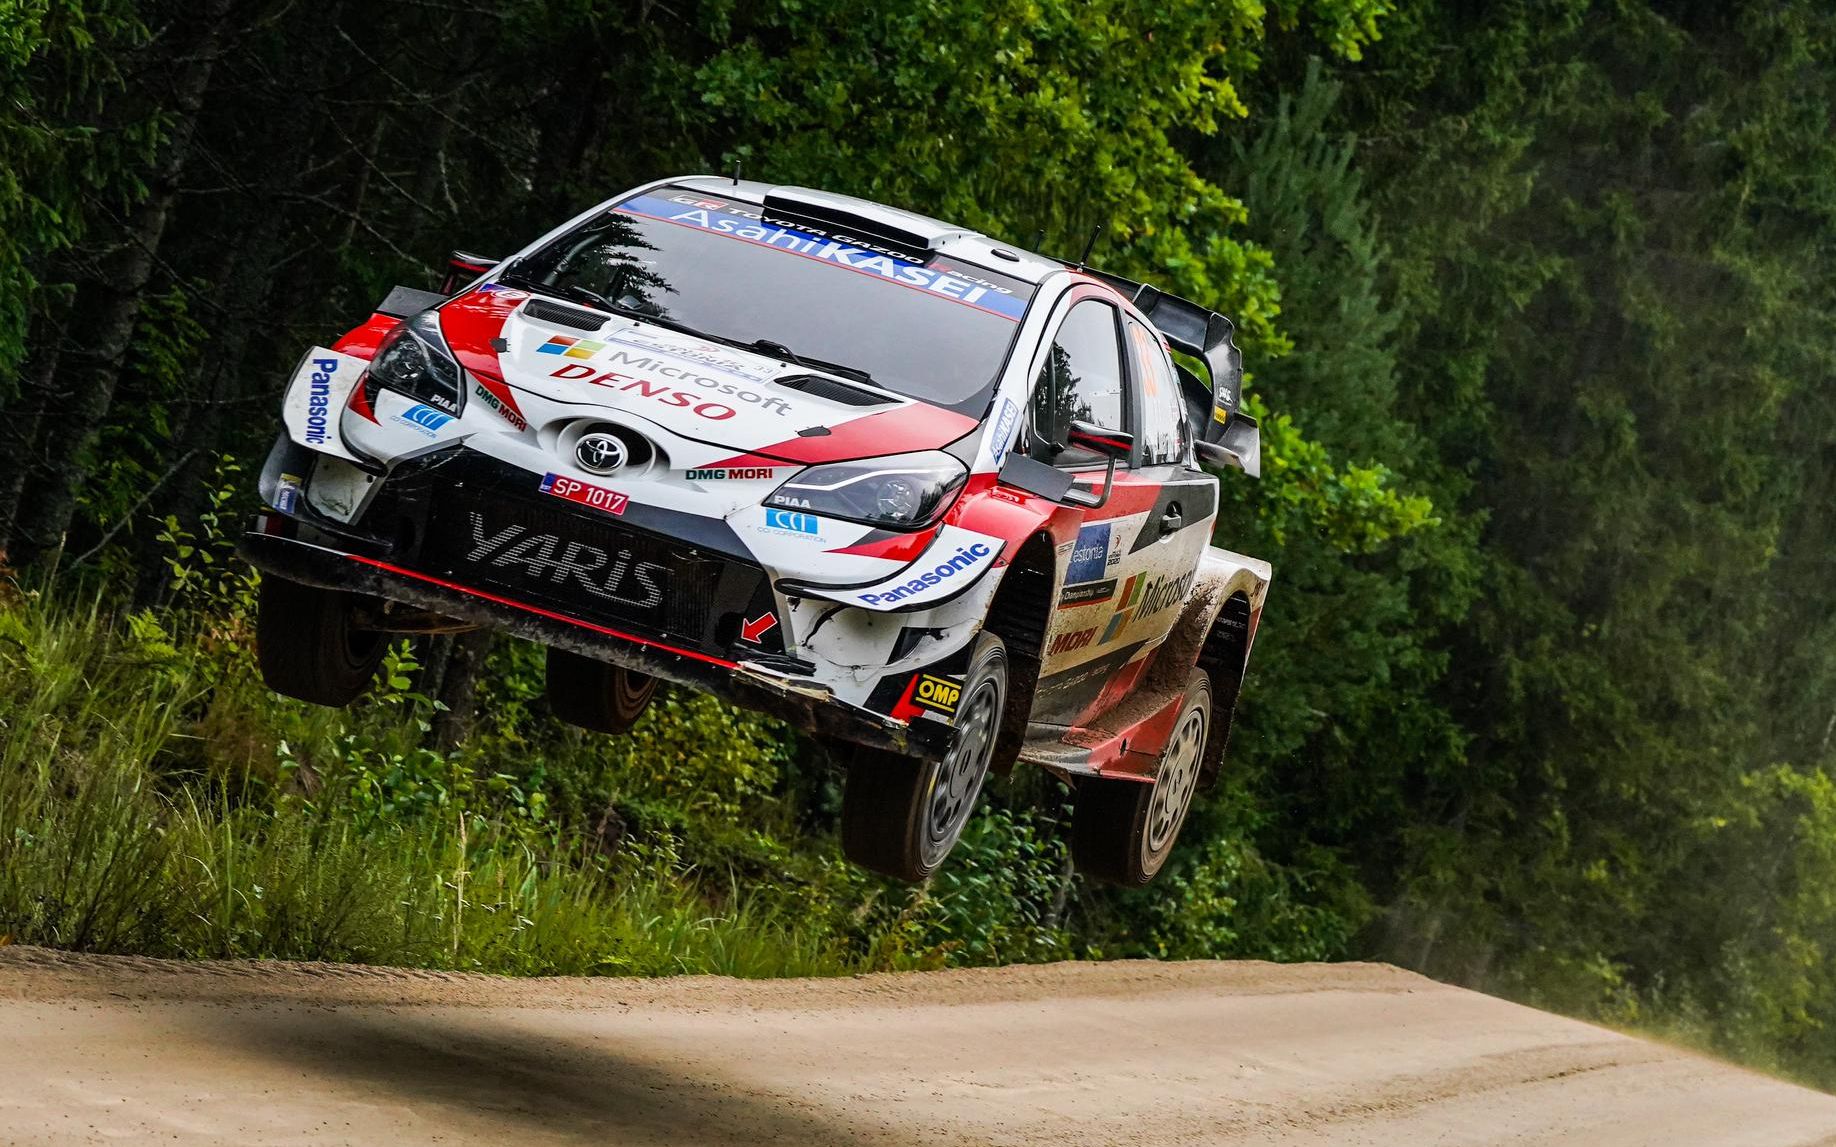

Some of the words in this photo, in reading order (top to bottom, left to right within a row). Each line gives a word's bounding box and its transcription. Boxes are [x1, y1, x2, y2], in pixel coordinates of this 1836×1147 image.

[728, 207, 827, 236] TOYOTA
[831, 235, 925, 264] GAZOO
[305, 359, 338, 444] Panasonic
[430, 394, 457, 412] PIAA
[550, 364, 736, 420] DENSO
[609, 351, 792, 416] Microsoft
[475, 384, 498, 409] DMG
[498, 403, 527, 432] MORI
[554, 478, 581, 496] SP
[585, 487, 625, 510] 1017
[685, 469, 725, 480] DMG
[728, 469, 773, 479] MORI
[774, 495, 811, 508] PIAA
[857, 543, 990, 605] Panasonic
[1048, 625, 1099, 656] MORI
[919, 680, 960, 705] OMP
